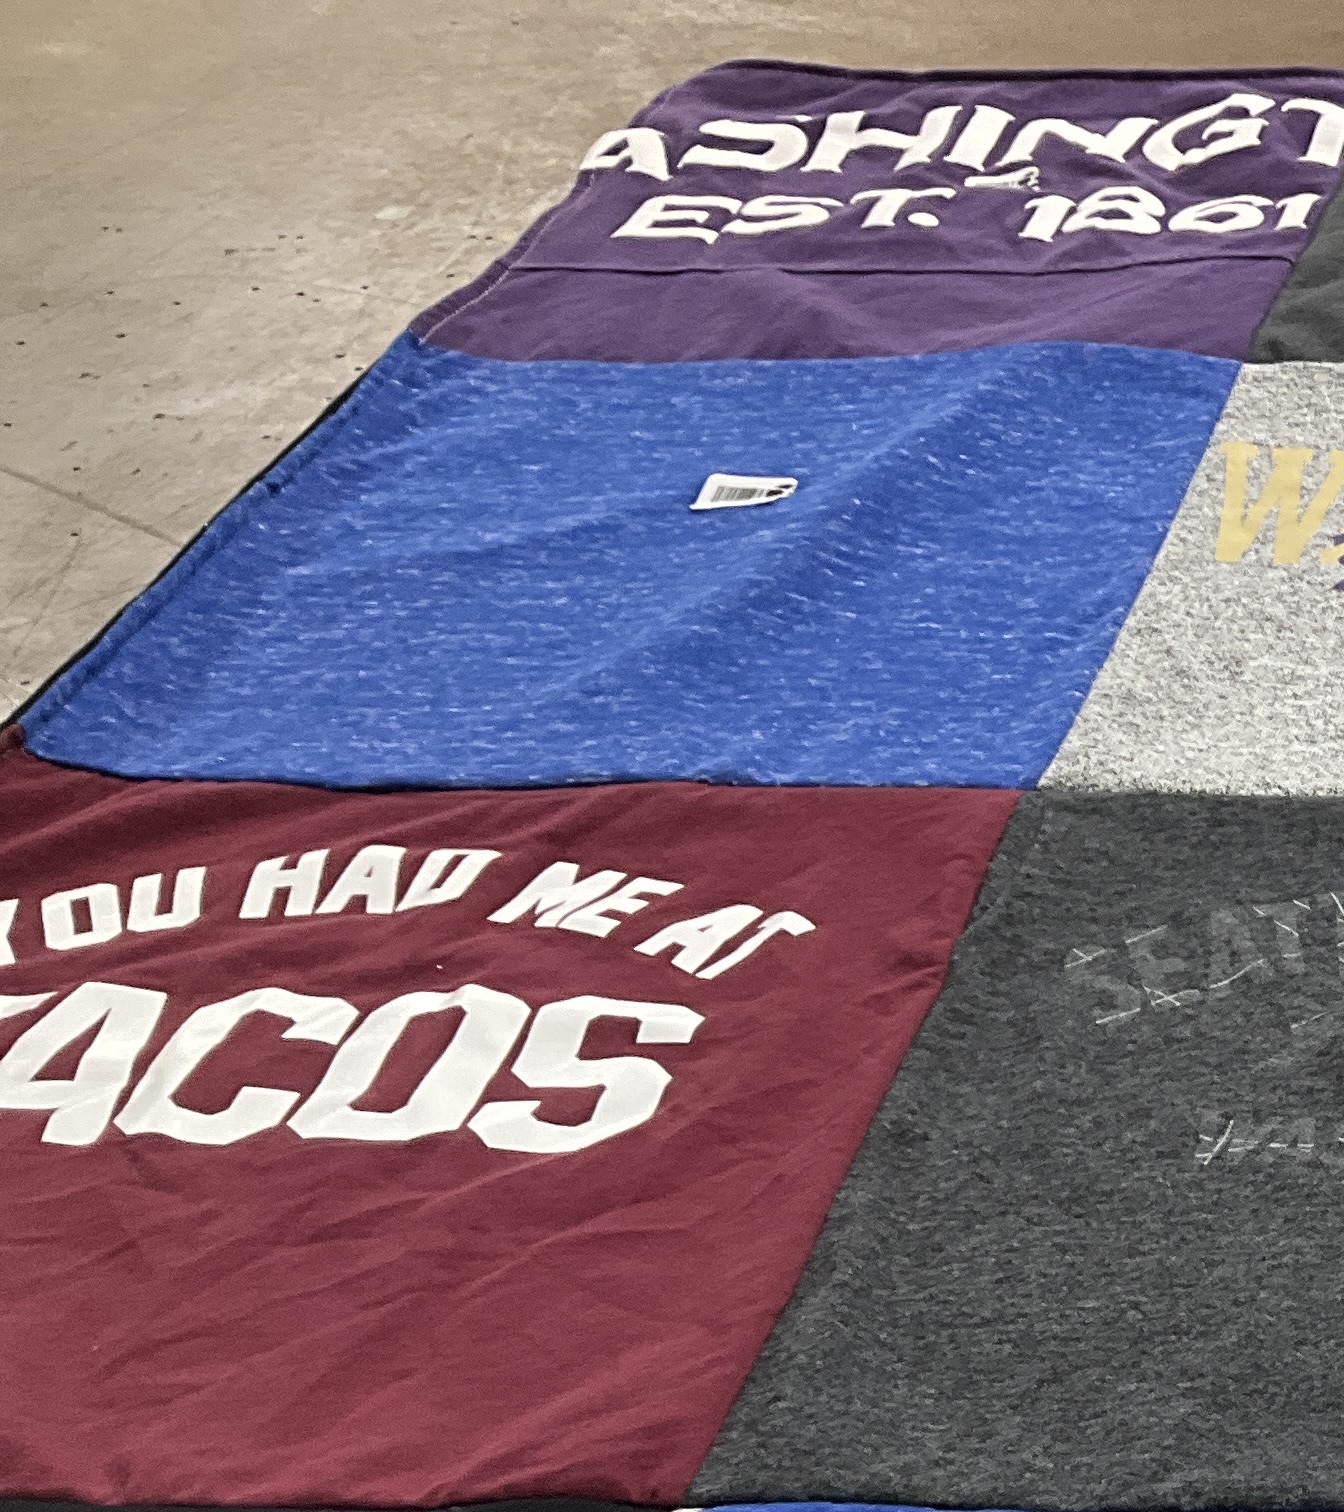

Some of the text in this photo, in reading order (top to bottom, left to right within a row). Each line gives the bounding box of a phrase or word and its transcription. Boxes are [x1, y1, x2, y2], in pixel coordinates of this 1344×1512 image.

[611, 185, 1322, 246] EST. 1861
[239, 844, 503, 921] HAD
[487, 860, 685, 938] ME
[633, 903, 817, 980] AT
